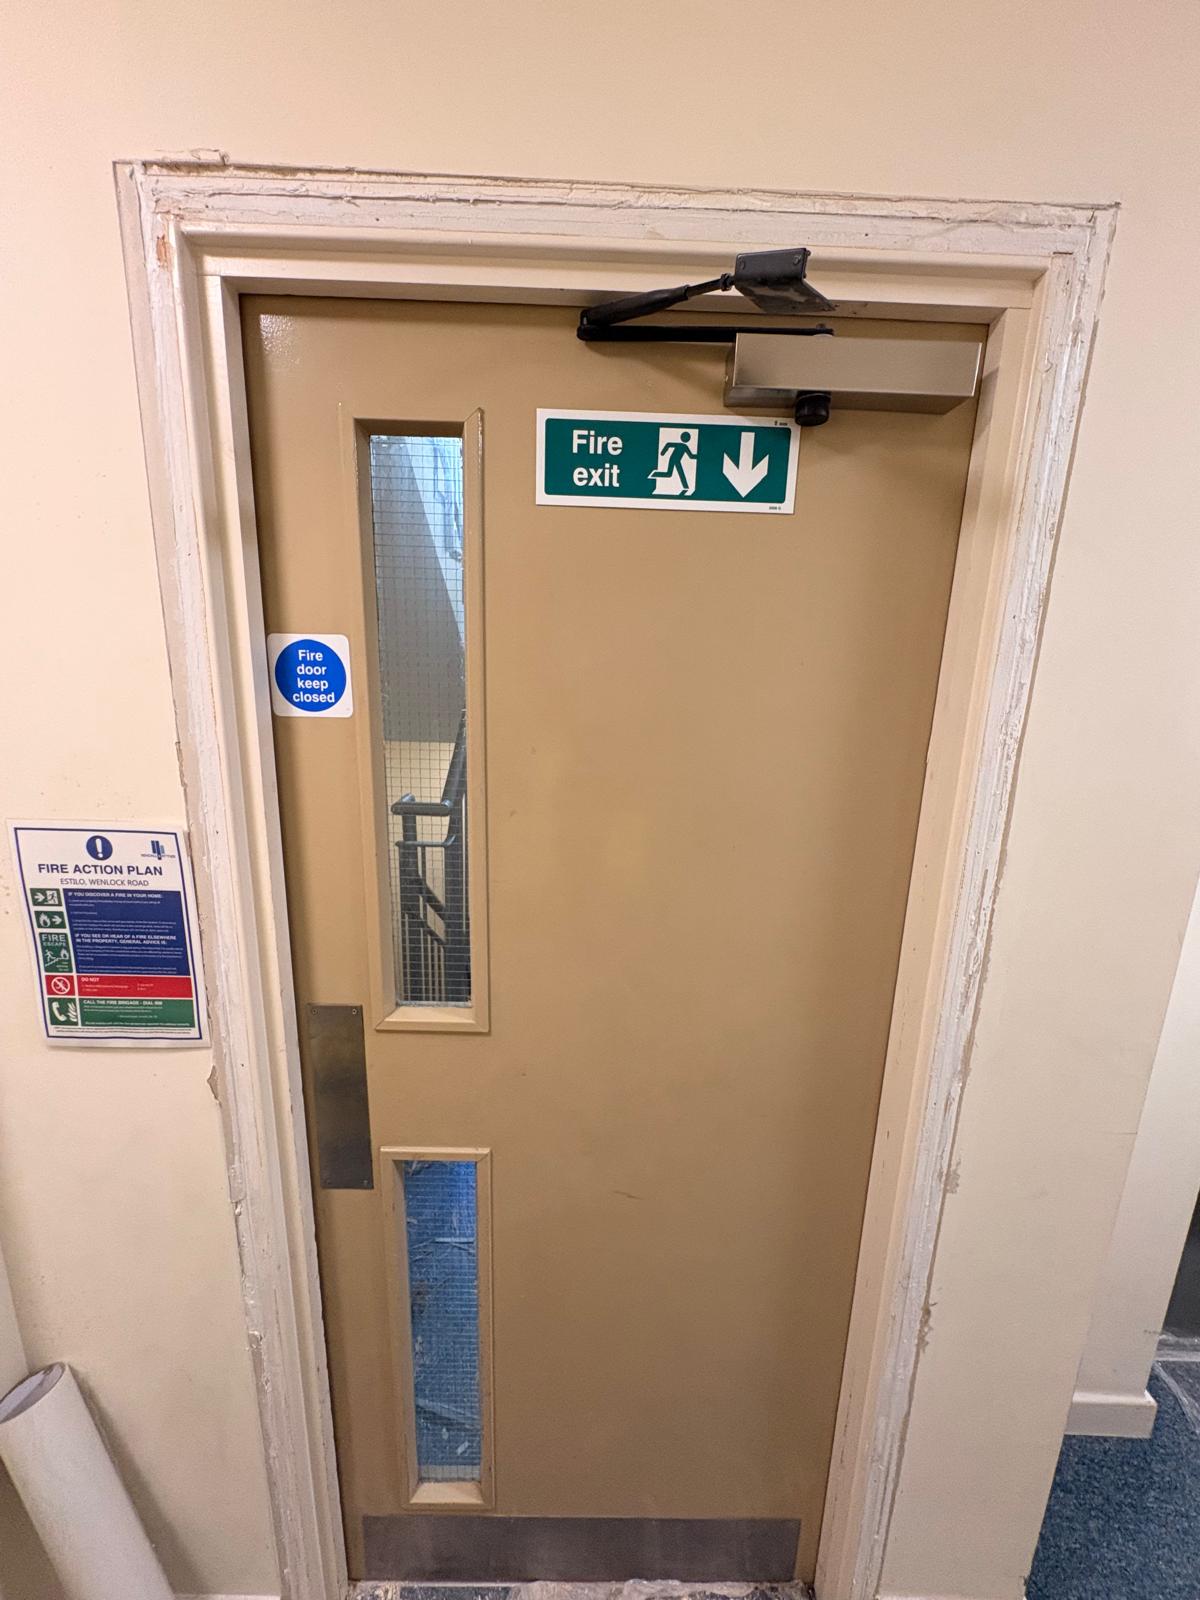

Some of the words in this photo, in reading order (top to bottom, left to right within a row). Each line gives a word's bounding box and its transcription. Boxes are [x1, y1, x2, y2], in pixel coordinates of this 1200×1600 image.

[572, 429, 623, 455] Fire
[572, 463, 620, 488] exit
[298, 649, 323, 661] Fire
[296, 664, 327, 675] door
[297, 677, 329, 691] keep
[292, 691, 335, 703] closed
[38, 863, 69, 874] FIRE
[73, 864, 123, 875] ACTION
[127, 865, 163, 876] PLAN
[60, 878, 87, 886] ESTILO,
[88, 878, 126, 886] WENLOCK
[127, 879, 149, 887] ROAD
[41, 934, 66, 942] FIRE
